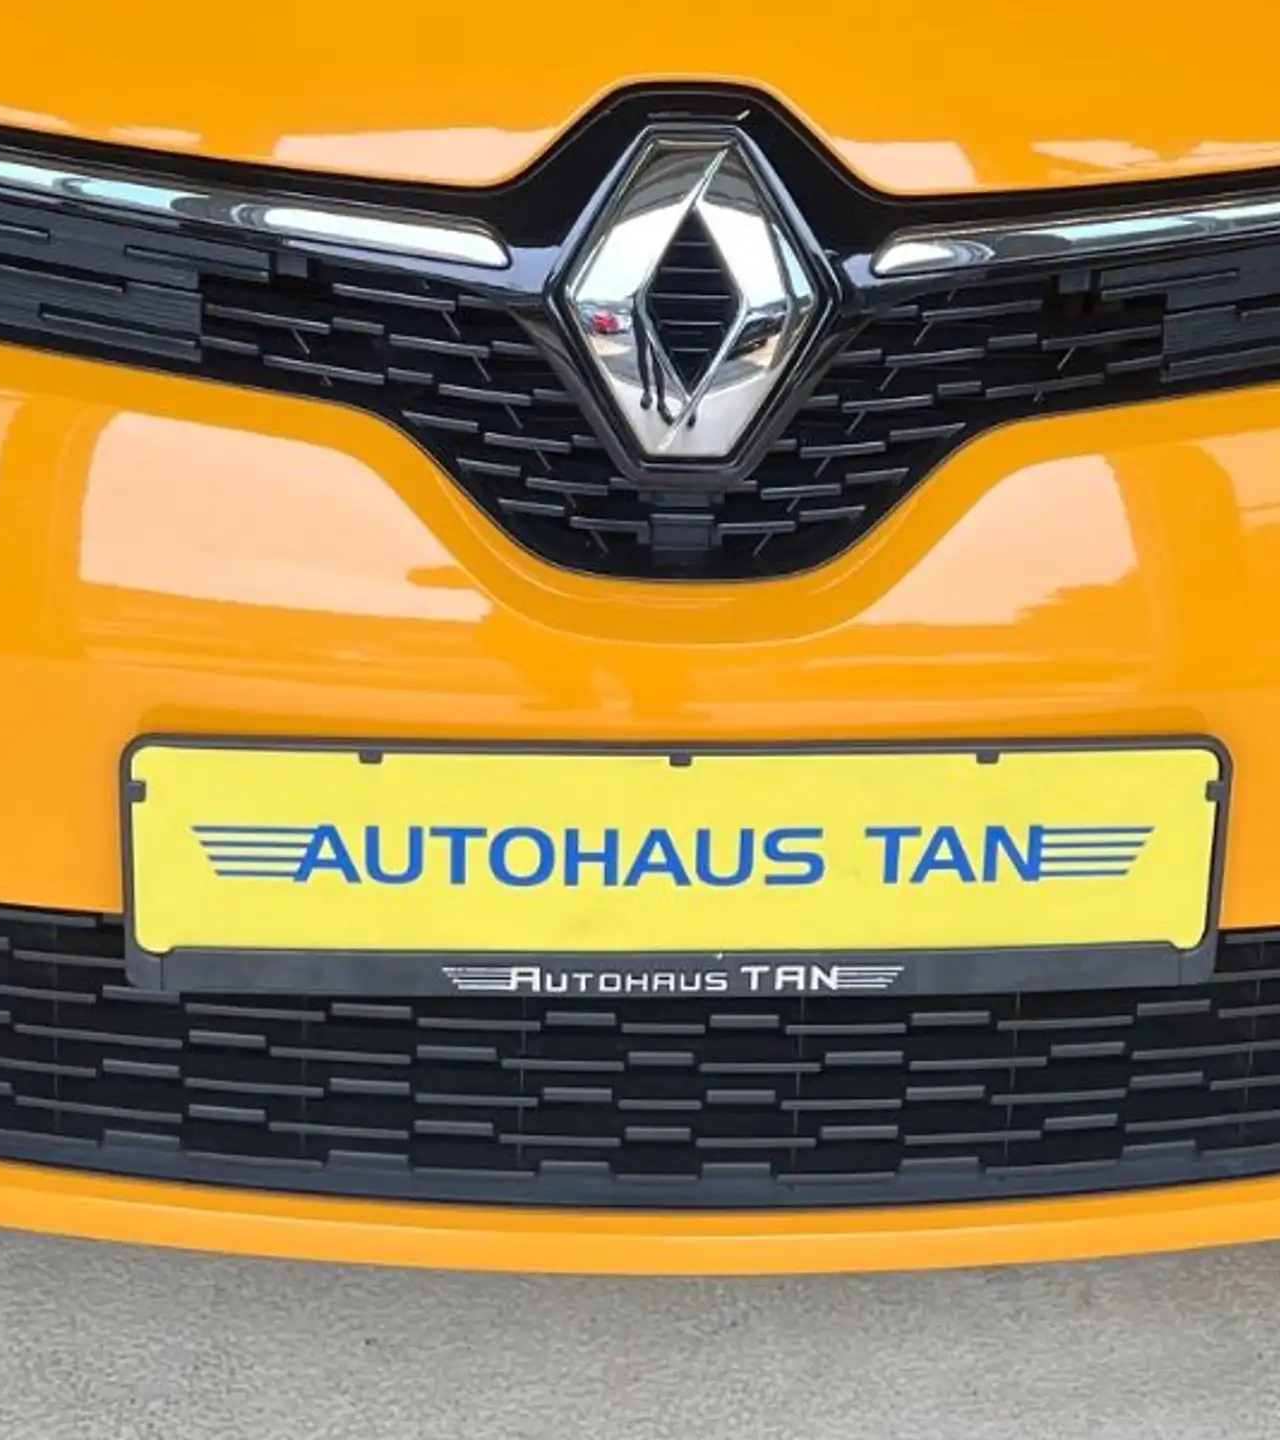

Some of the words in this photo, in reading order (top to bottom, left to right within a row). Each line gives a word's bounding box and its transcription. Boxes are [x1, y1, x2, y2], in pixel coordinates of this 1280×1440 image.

[293, 823, 825, 888] AUTOHAUS
[865, 824, 1044, 884] TAN
[740, 965, 840, 991] TAN
